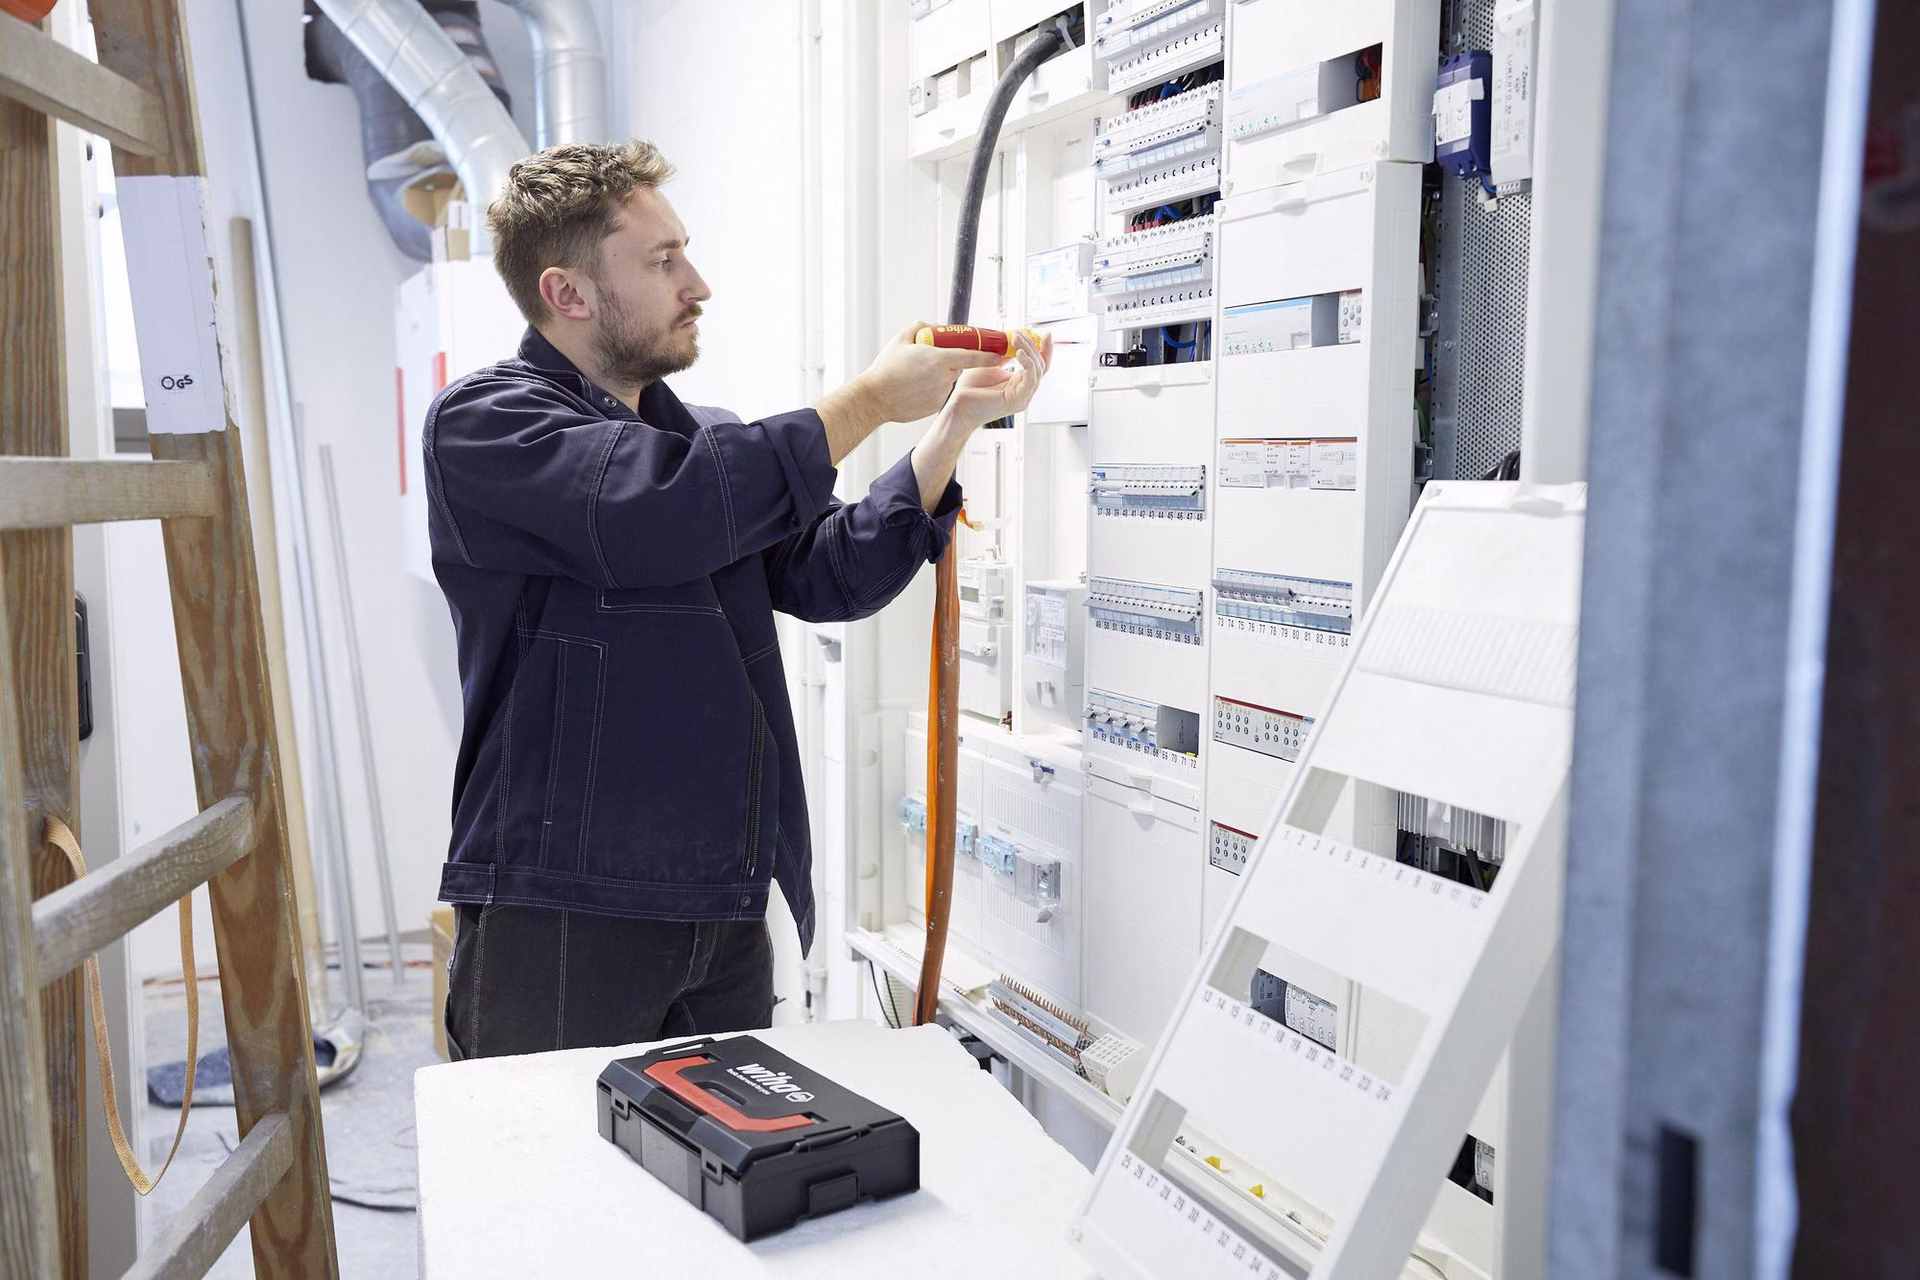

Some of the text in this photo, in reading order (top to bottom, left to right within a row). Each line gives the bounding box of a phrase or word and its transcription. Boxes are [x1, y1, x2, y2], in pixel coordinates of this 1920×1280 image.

[947, 326, 973, 334] wiha
[176, 375, 193, 389] GS
[1097, 508, 1103, 516] 37
[1105, 508, 1111, 516] 38
[1122, 509, 1128, 517] 40
[1140, 510, 1145, 518] 42
[1167, 512, 1173, 520] 45
[1177, 512, 1183, 520] 46
[1112, 623, 1117, 631] 51
[1121, 624, 1126, 632] 52
[1129, 625, 1135, 634] 53
[1138, 627, 1144, 635] 54
[1147, 628, 1153, 637] 55
[1156, 630, 1162, 639] 56
[1165, 632, 1171, 640] 57
[1175, 633, 1181, 642] 58
[1184, 635, 1190, 644] 59
[1194, 637, 1200, 645] 60
[1218, 617, 1348, 647] 73 74 75 76 77 78 79 80 81 82 83 84
[1093, 731, 1196, 768] 61 62 63 64 65 66 67 68 69 70 71 72
[735, 1063, 802, 1094] wiha
[1146, 1175, 1158, 1188] 27
[1174, 1196, 1185, 1211] 29
[1188, 1207, 1199, 1223] 30
[1217, 1231, 1229, 1247] 32
